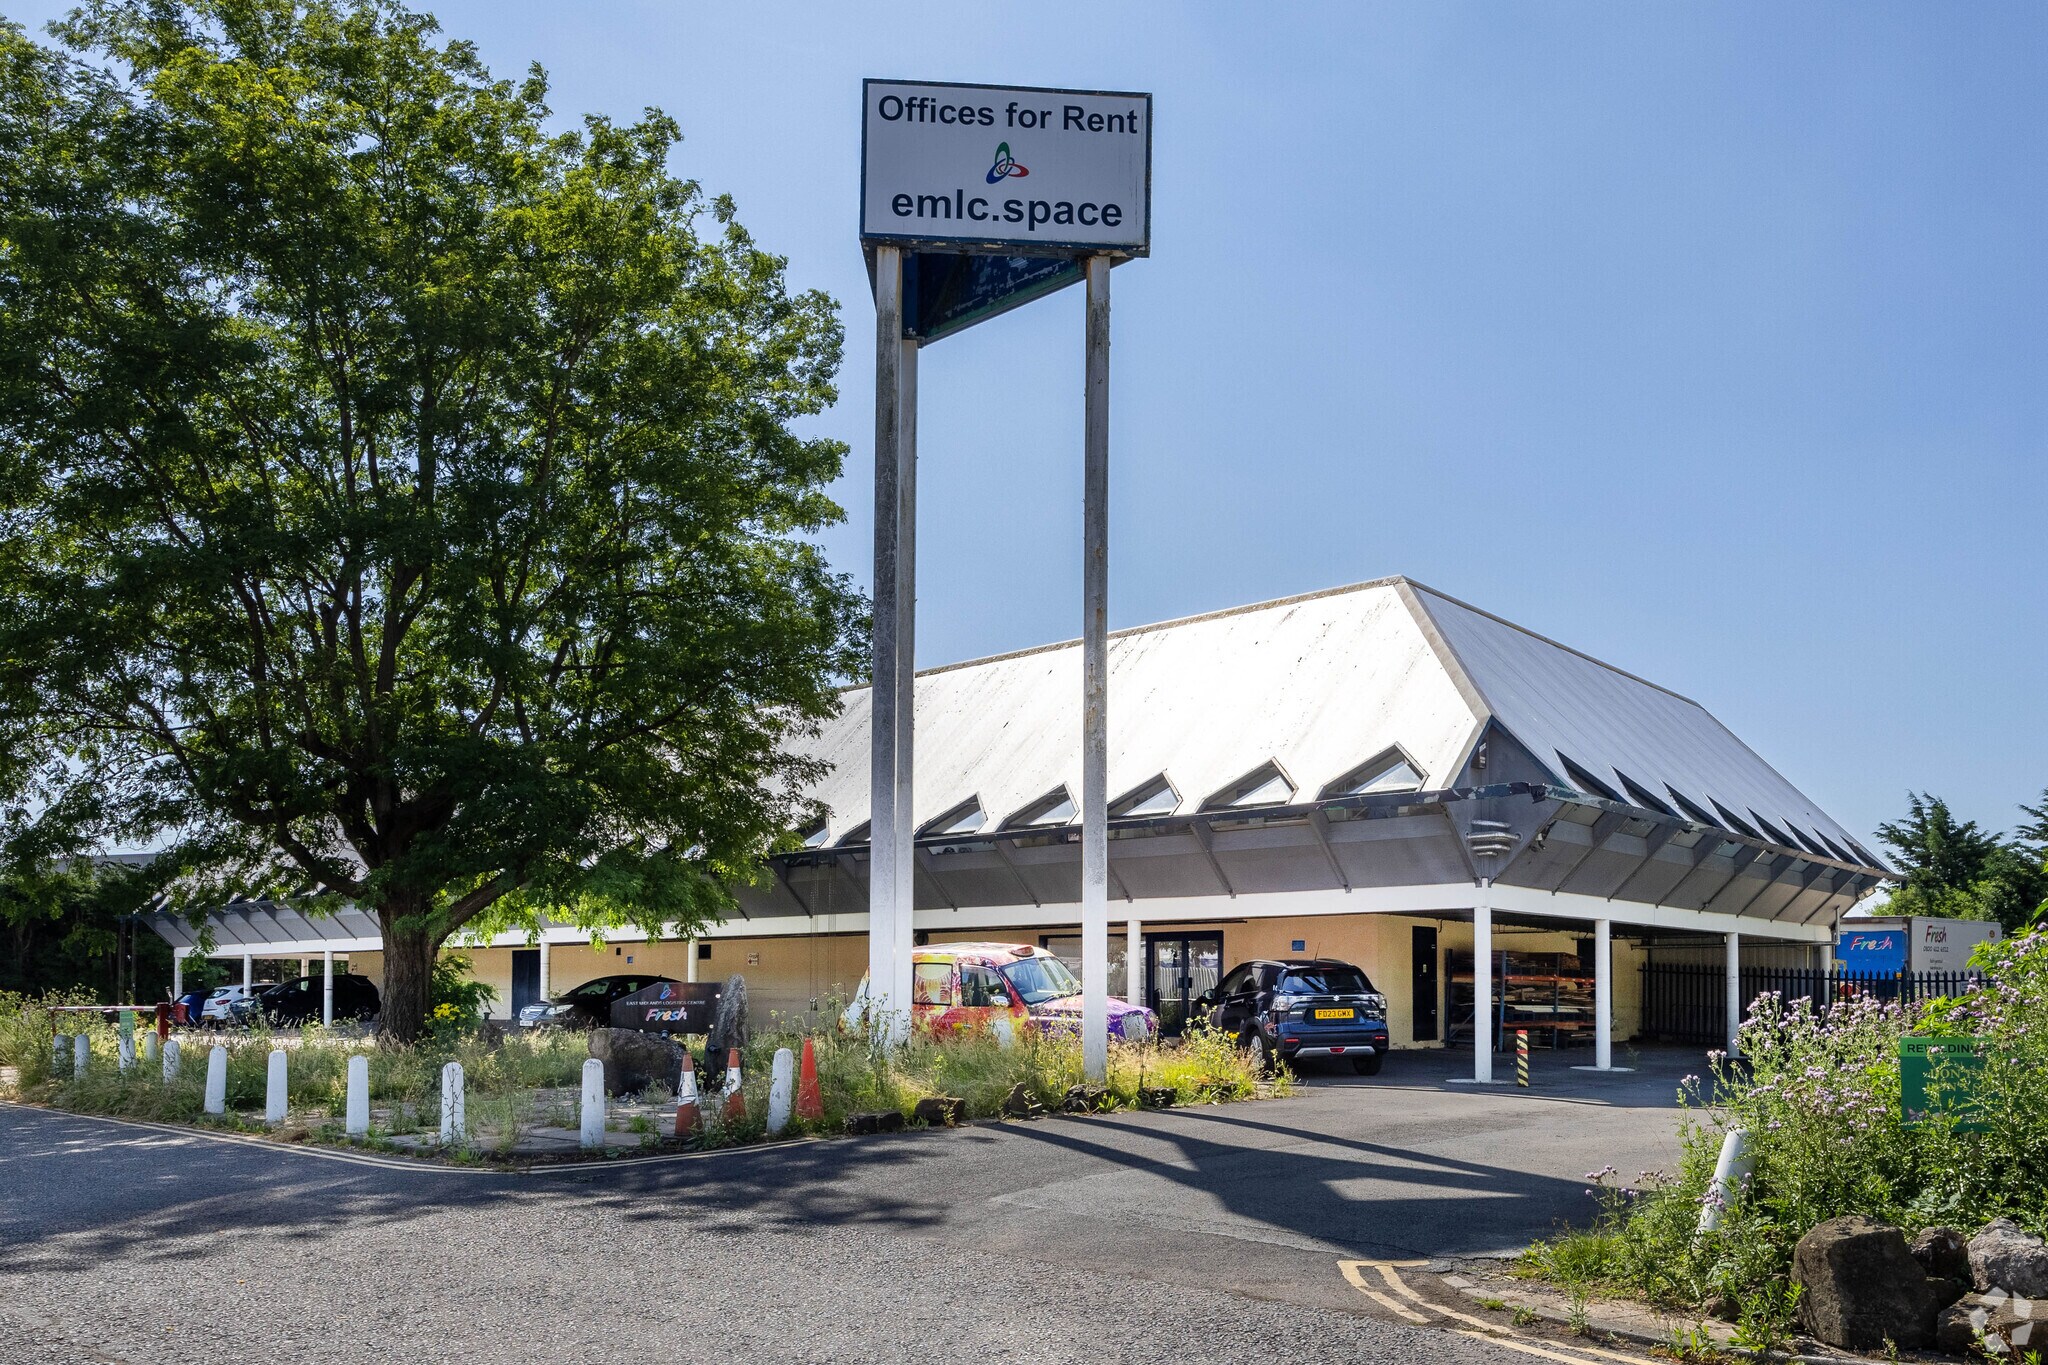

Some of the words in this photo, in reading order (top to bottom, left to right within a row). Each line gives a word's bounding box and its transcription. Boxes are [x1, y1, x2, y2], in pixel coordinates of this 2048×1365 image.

[878, 95, 995, 126] Offices
[1005, 101, 1052, 129] for
[1062, 105, 1138, 134] Rent
[891, 189, 1122, 232] emlc.space
[1925, 924, 1947, 943] Fresh
[1850, 936, 1893, 951] Fresh
[645, 1006, 688, 1022] Fresh
